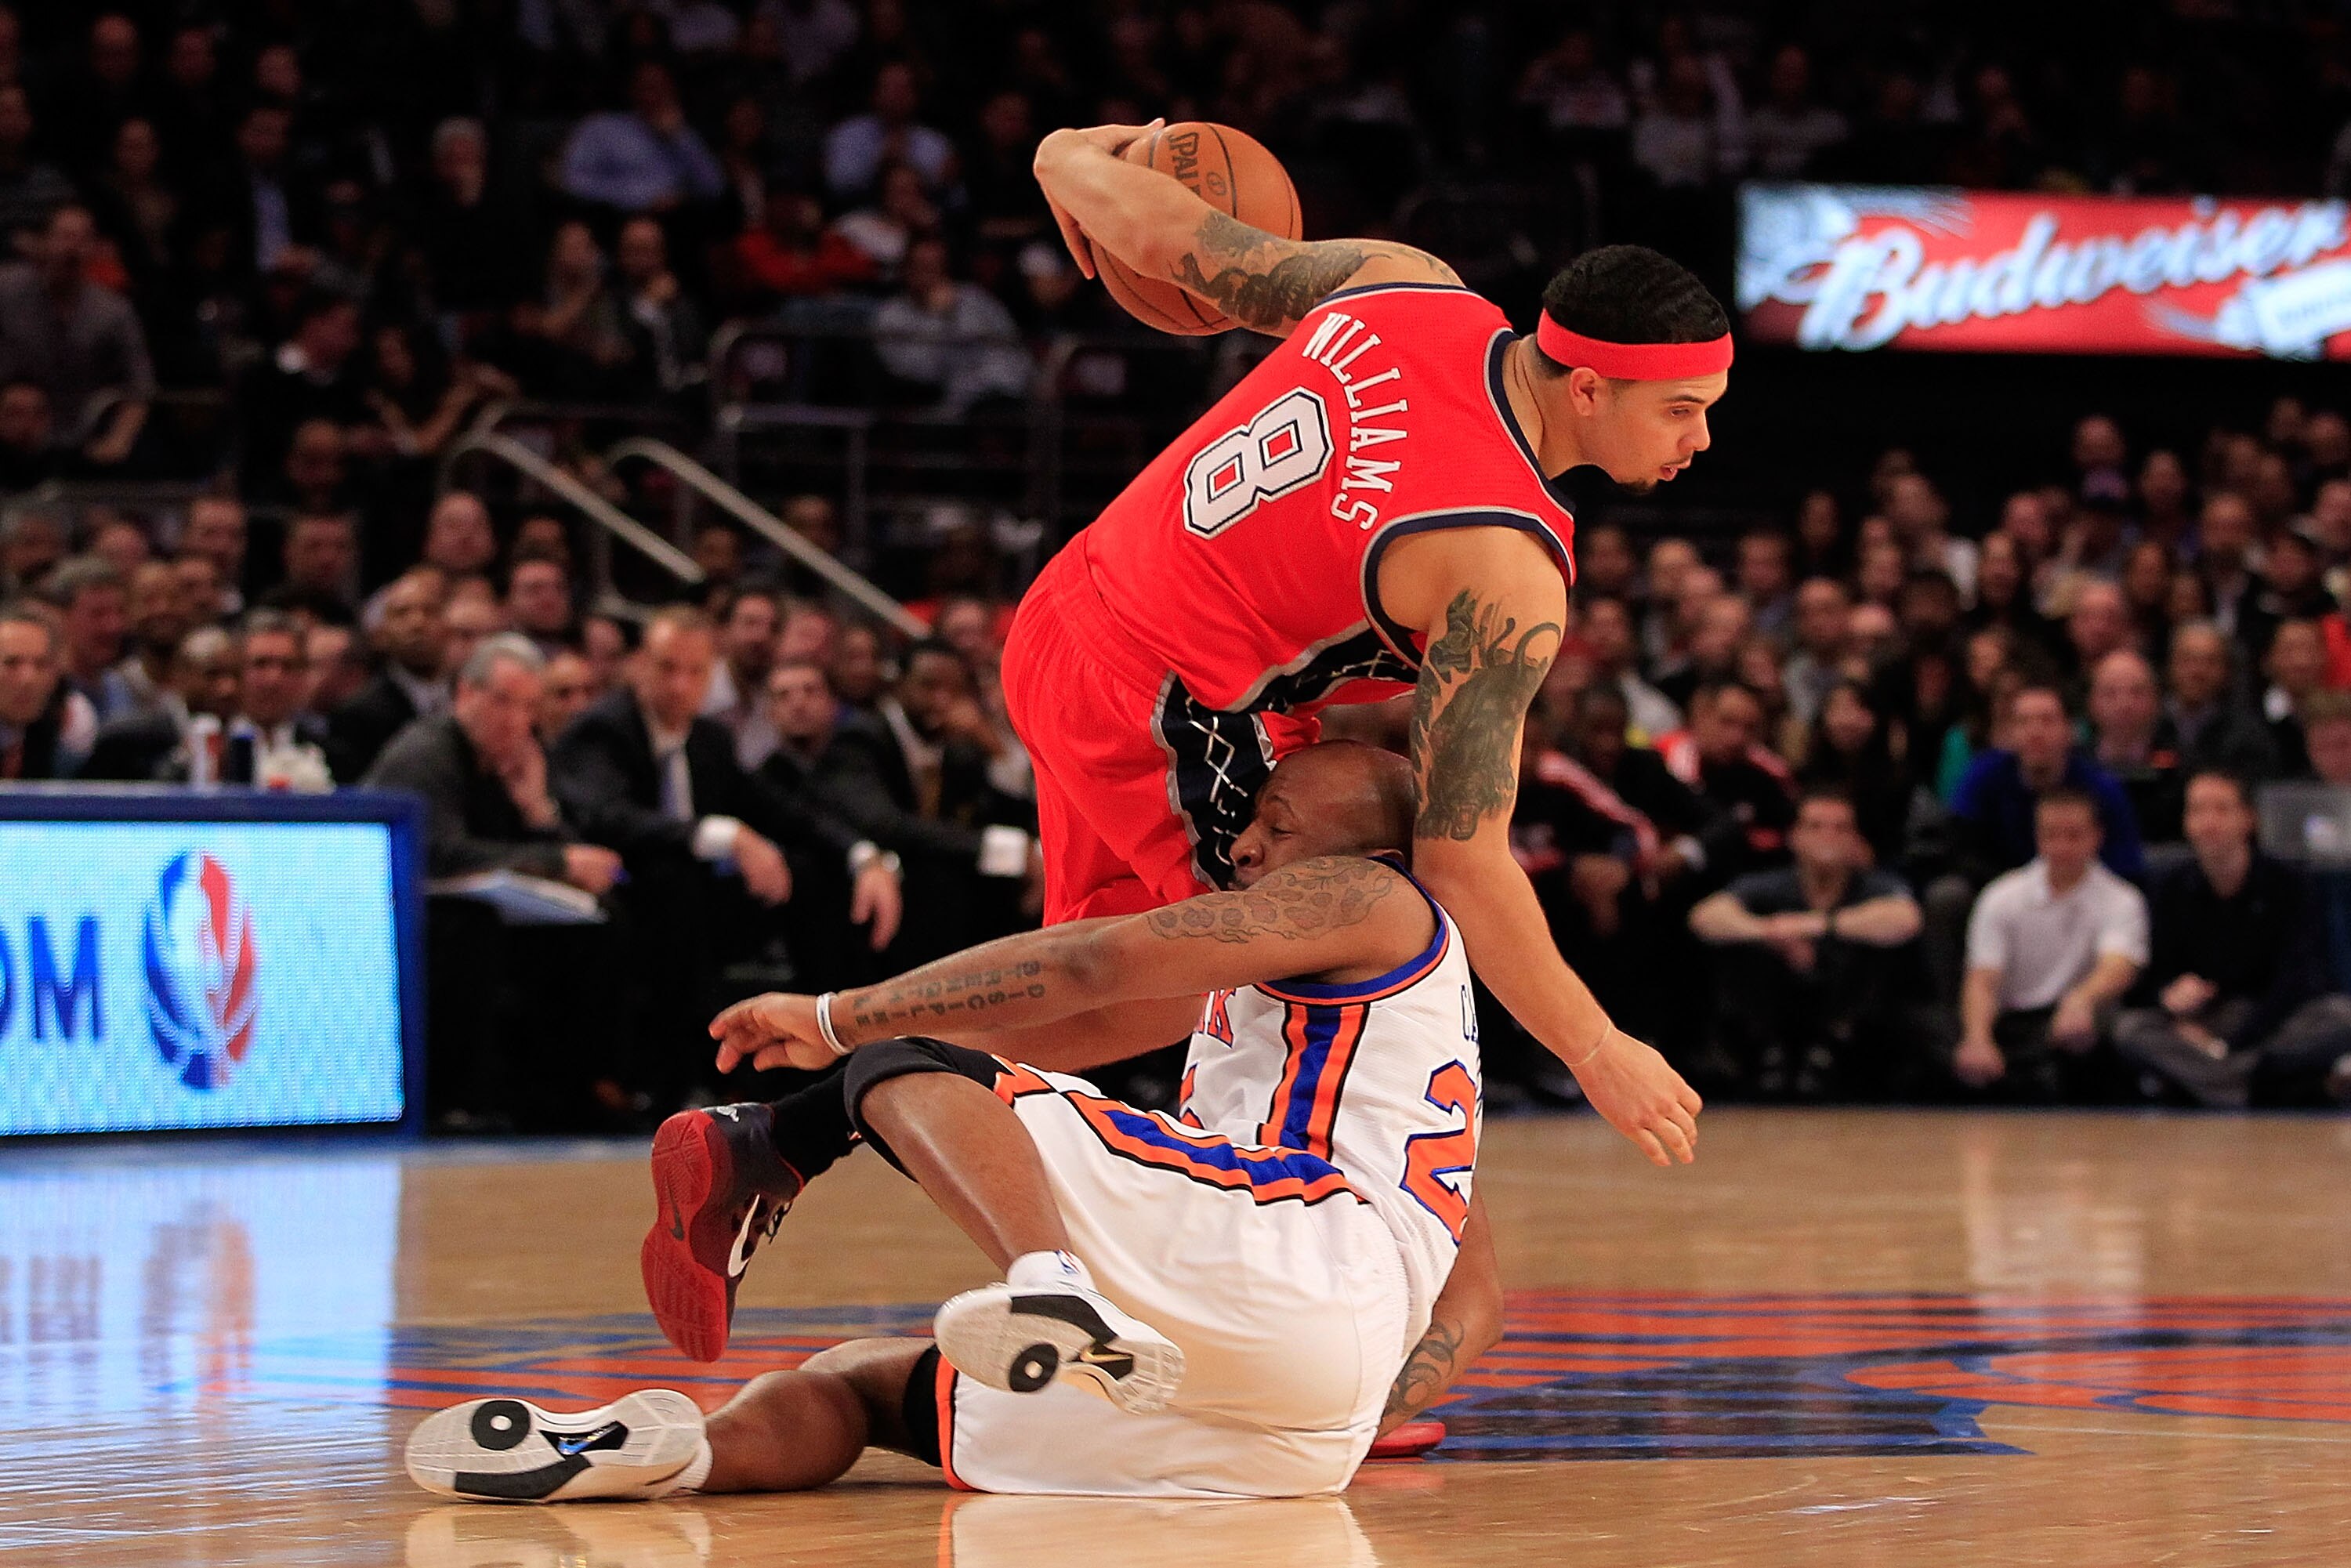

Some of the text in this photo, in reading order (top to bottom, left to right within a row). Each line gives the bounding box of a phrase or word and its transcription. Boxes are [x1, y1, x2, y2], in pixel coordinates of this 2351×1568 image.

[1796, 197, 2348, 351] Budweiser
[1182, 385, 1335, 541] 8
[1302, 312, 1409, 531] WILLIAMS
[0, 914, 100, 1042] M
[1195, 987, 1237, 1048] K
[1399, 1058, 1484, 1248] 2
